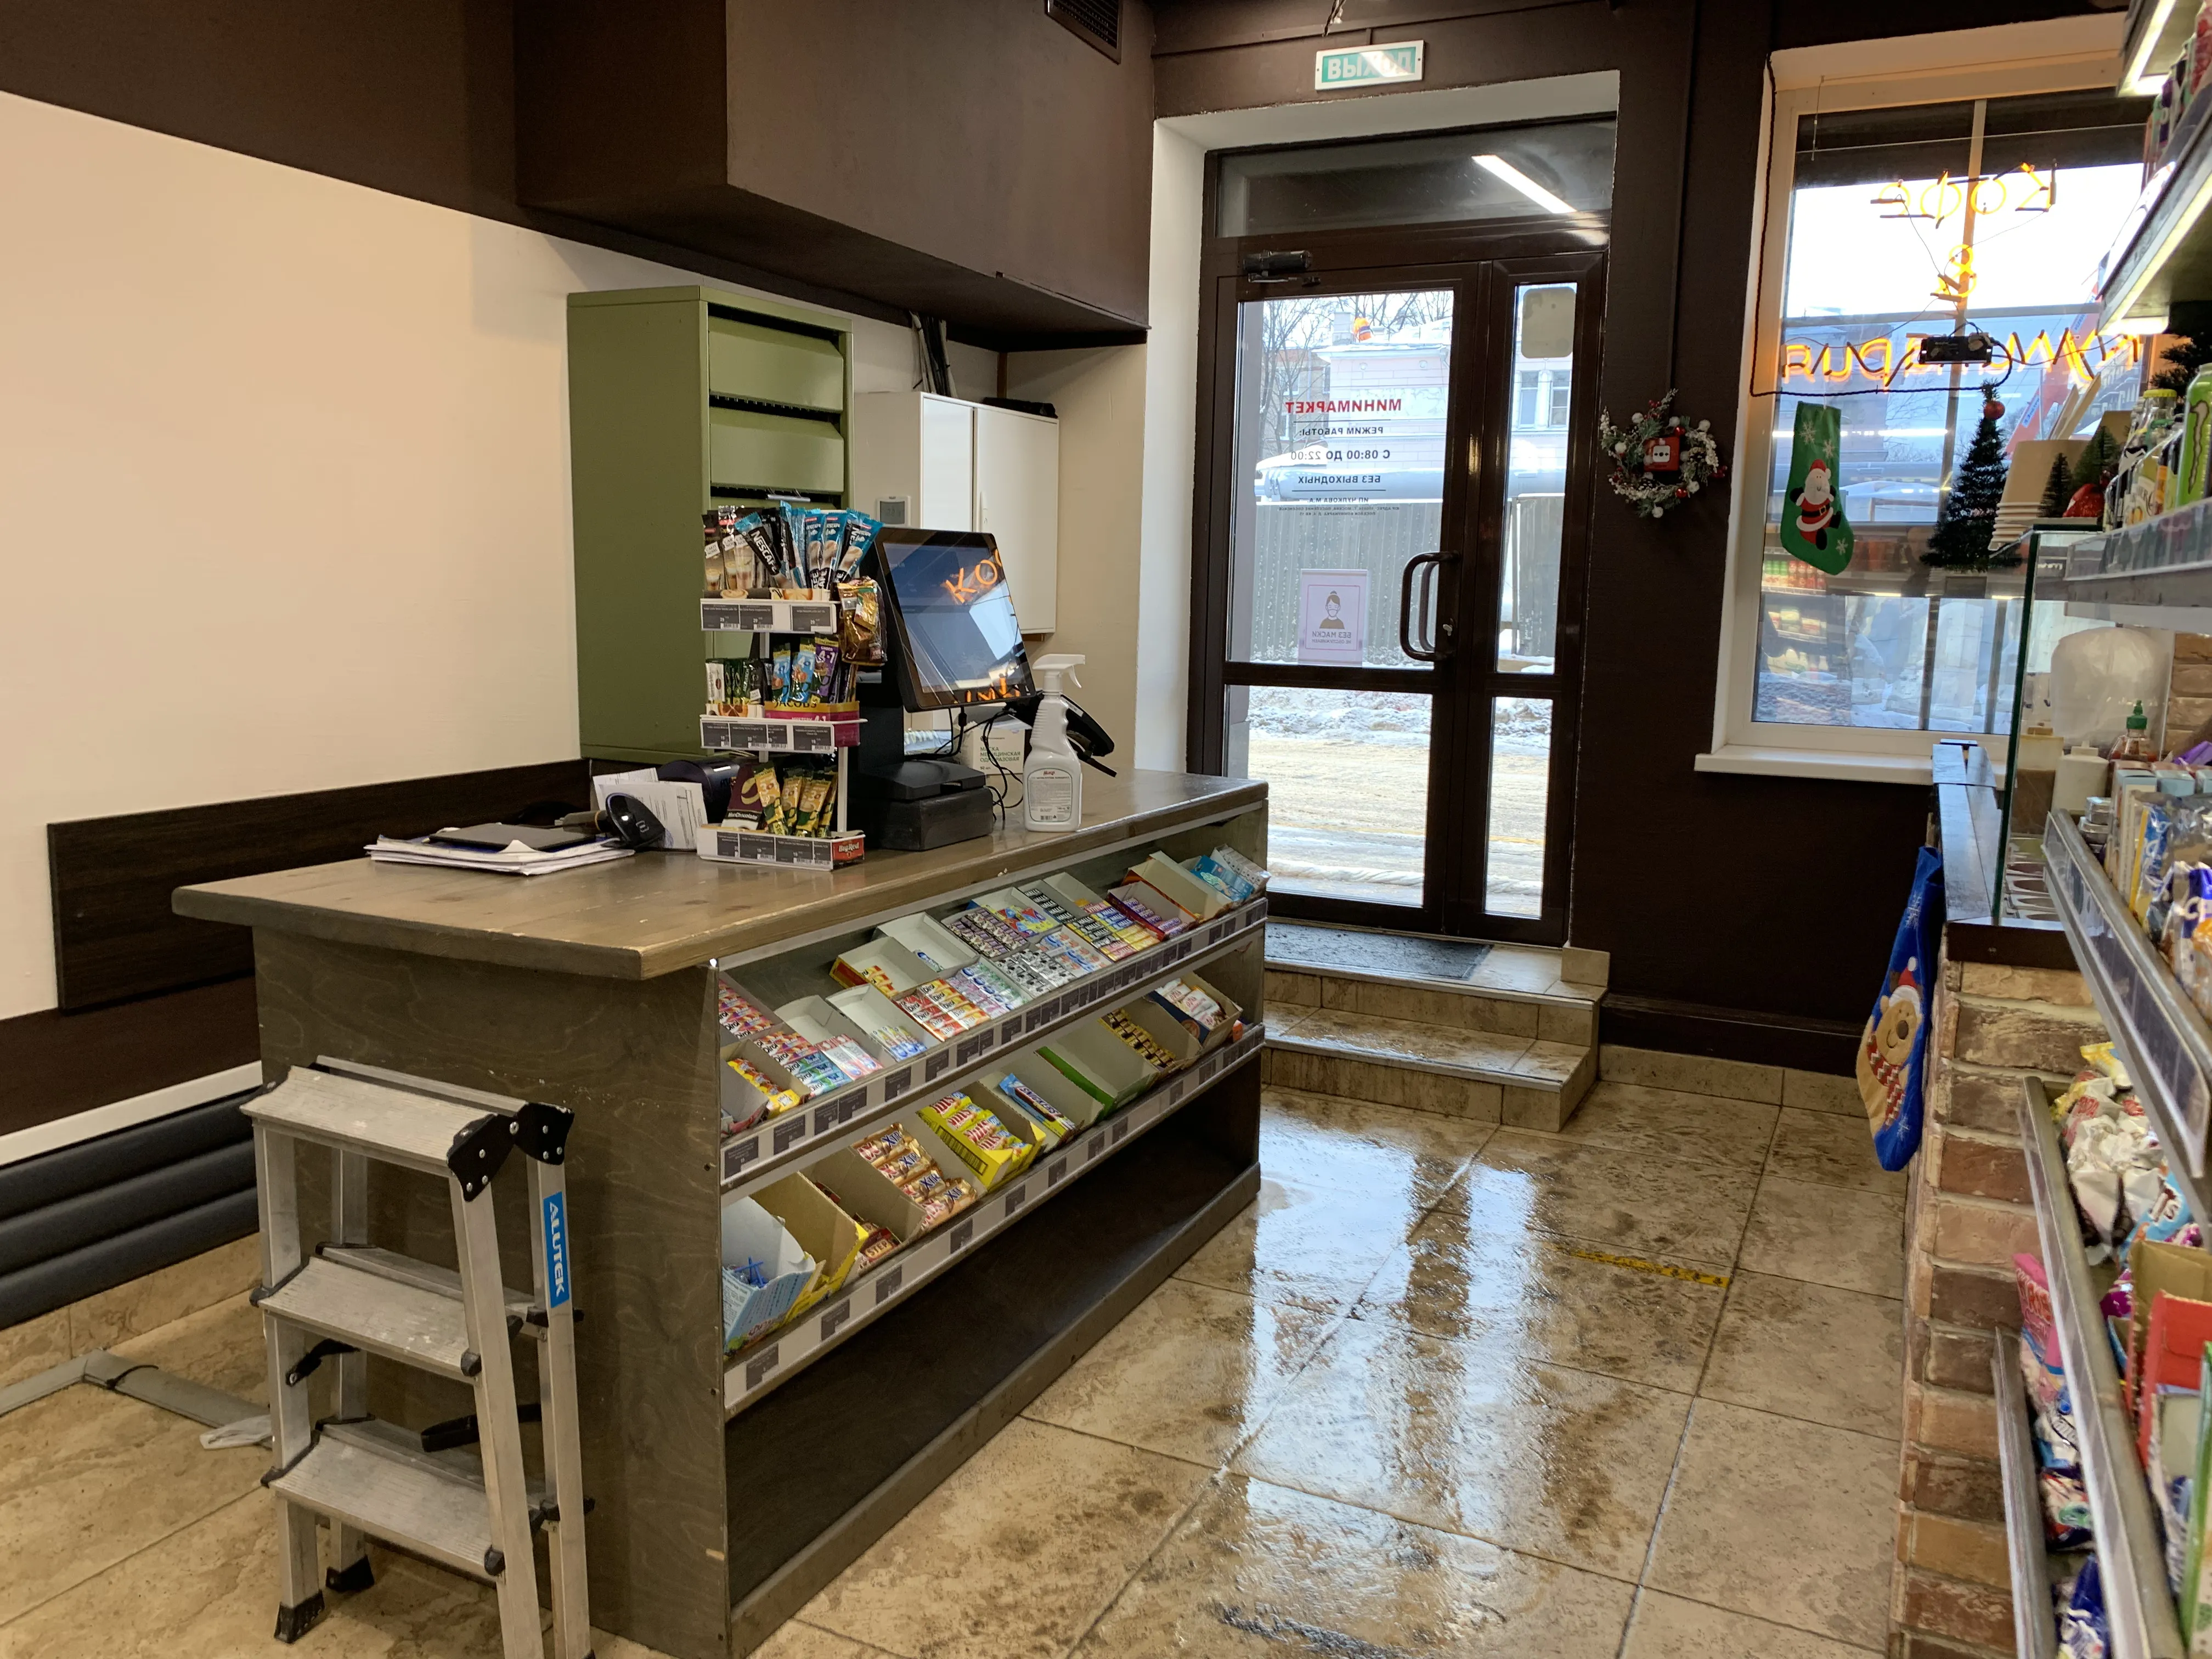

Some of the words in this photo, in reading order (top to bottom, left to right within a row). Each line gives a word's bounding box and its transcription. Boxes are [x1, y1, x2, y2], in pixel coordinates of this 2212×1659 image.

[1025, 889, 1040, 897] HALLS
[1033, 895, 1048, 903] HALLS
[1041, 900, 1056, 909] HALLS
[1048, 906, 1063, 915] HALLS
[1102, 907, 1116, 916] HALLS
[1057, 912, 1072, 921] HALLS
[1077, 916, 1093, 924] HALLS
[1109, 913, 1124, 921] HALLS
[1118, 918, 1132, 927] HALLS
[1093, 928, 1109, 936] HALLS
[924, 983, 935, 994] Dirol
[934, 992, 945, 1001] Dirol
[907, 1002, 921, 1013] Dirol
[943, 1000, 955, 1009] Dirol
[917, 1011, 930, 1020] Dirol
[953, 1008, 965, 1017] Dirol
[763, 1043, 778, 1053] Dirol
[774, 1052, 789, 1063] Dirol
[786, 1062, 800, 1073] Dirol
[798, 1071, 812, 1082] Dirol
[881, 1131, 902, 1148] XTR
[899, 1153, 919, 1169] XTR
[549, 1201, 565, 1298] ALUTEK
[867, 1240, 888, 1256] STEP
